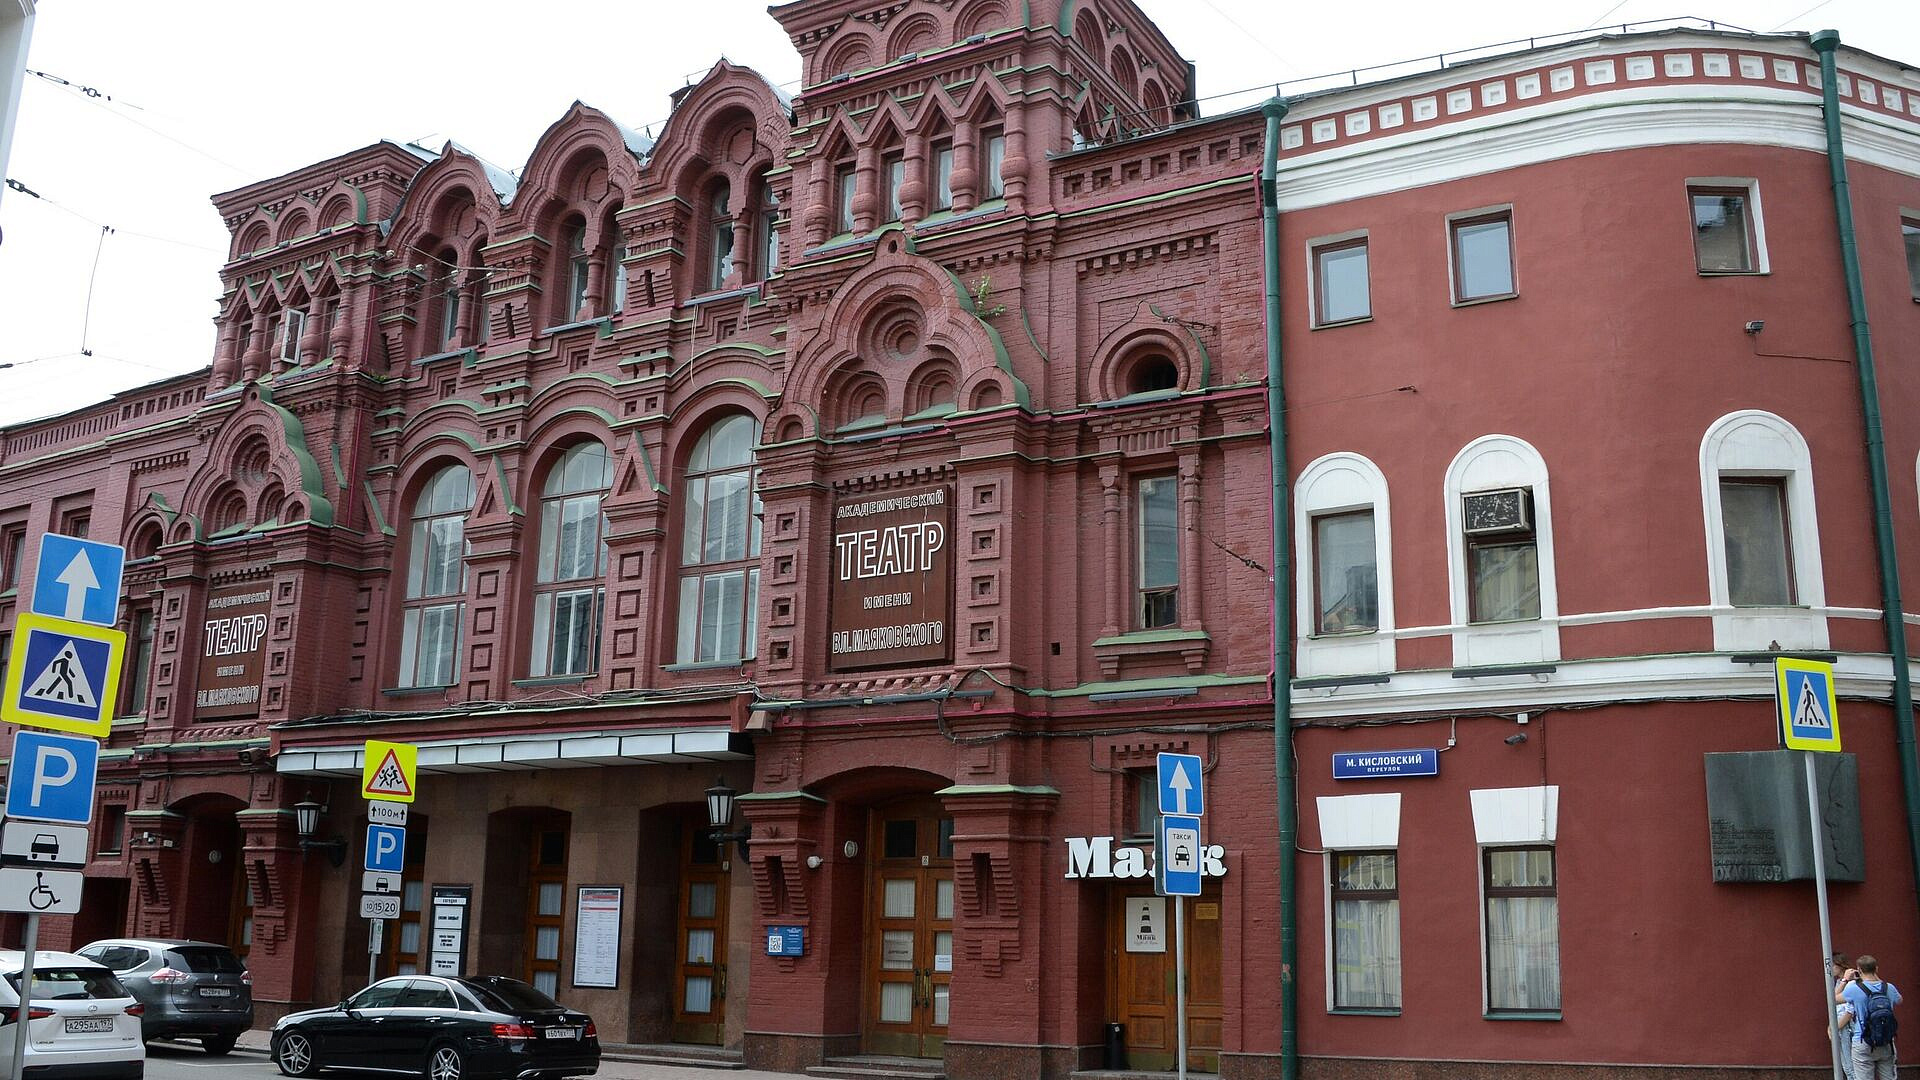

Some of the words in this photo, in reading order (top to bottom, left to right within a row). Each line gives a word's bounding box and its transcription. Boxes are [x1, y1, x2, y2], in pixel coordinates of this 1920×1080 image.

[836, 489, 944, 518] АКАДЕМИЧЕСКИЙ
[836, 521, 944, 581] ТЕАТР
[864, 592, 911, 609] ИМЕНИ
[205, 613, 267, 657] ТЕАТР
[30, 745, 78, 807] P
[1346, 759, 1357, 767] М.
[1359, 754, 1422, 767] КИСЛОВСКИЙ
[375, 831, 397, 865] P
[1064, 836, 1228, 879] Мак
[366, 902, 373, 910] 10
[374, 902, 382, 911] 15
[384, 902, 396, 912] 20
